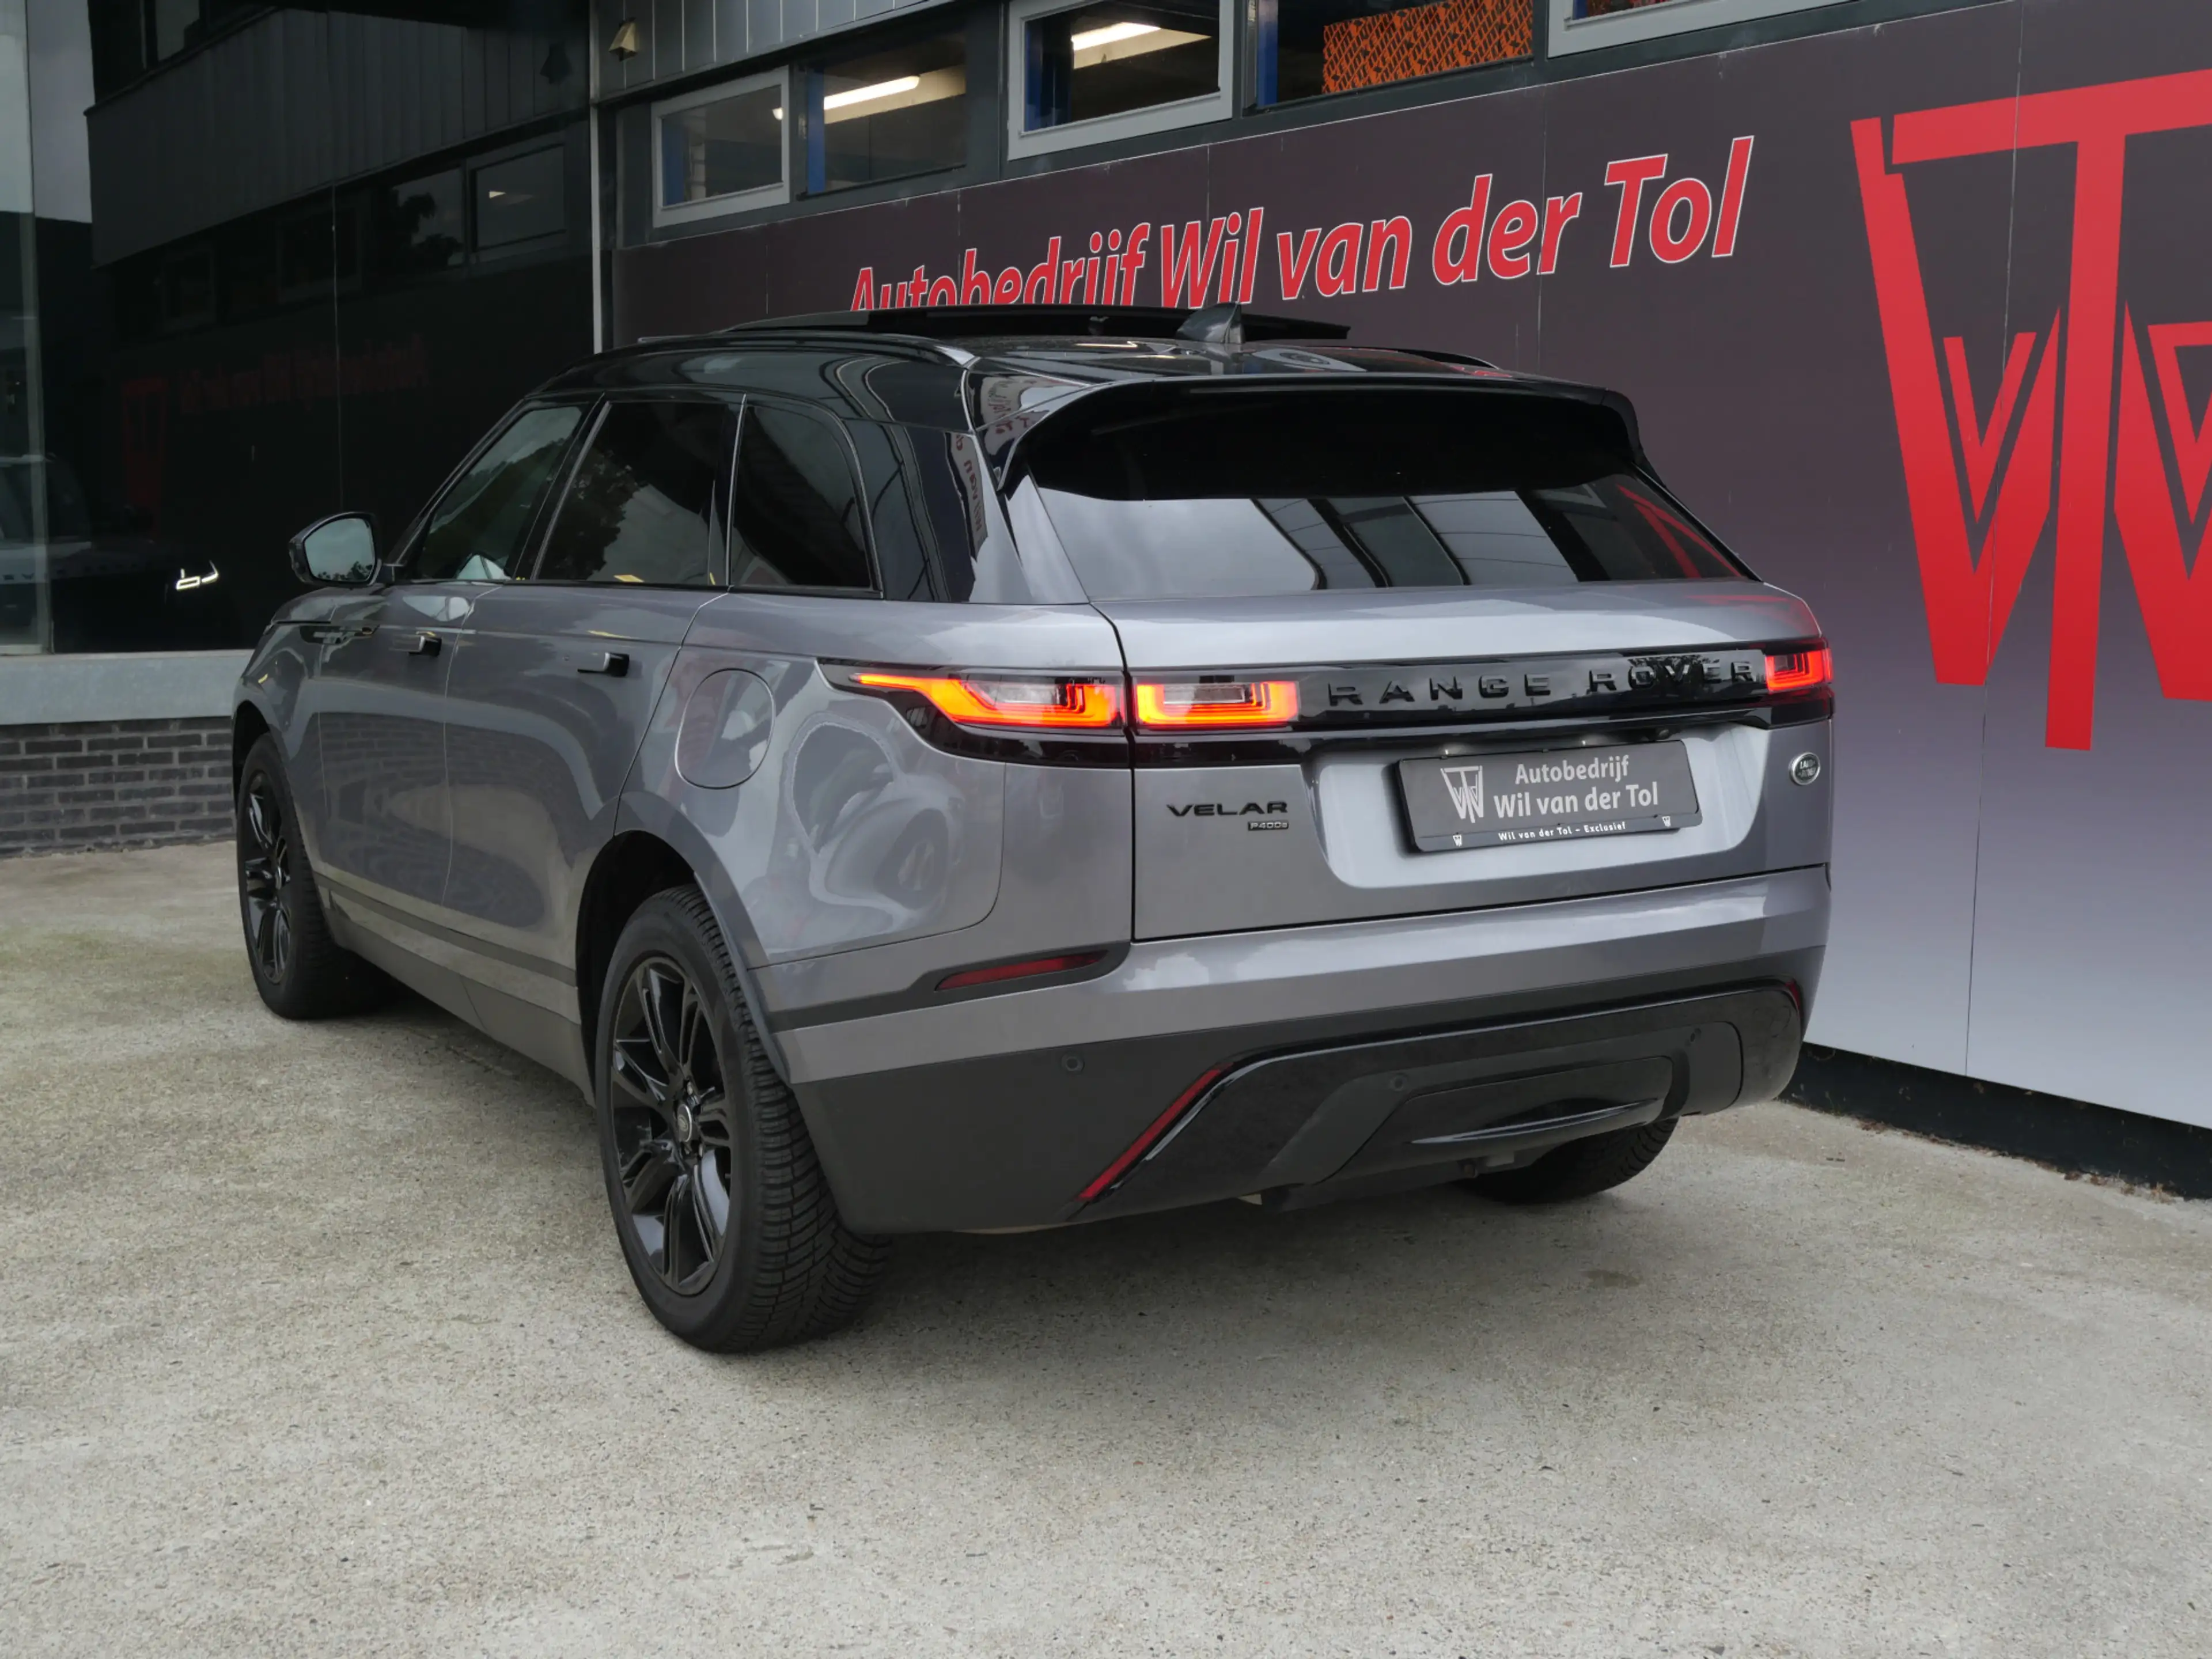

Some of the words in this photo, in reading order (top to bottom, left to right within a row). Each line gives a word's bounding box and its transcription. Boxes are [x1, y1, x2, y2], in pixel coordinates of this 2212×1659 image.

[1161, 207, 1264, 309] Wil
[1277, 215, 1412, 300] van
[1432, 173, 1582, 285] der
[1604, 135, 1754, 268] Tol
[1328, 673, 1551, 706] RANGE
[1587, 661, 1752, 692] ROVER
[1515, 755, 1629, 785] Autobedrijf
[1166, 801, 1289, 817] VELAR
[1494, 791, 1531, 819] Wil
[1536, 794, 1578, 815] van
[1585, 786, 1621, 811] der
[1626, 781, 1658, 807] Tol
[1498, 831, 1516, 841] Wil
[1539, 828, 1554, 838] der
[1556, 826, 1573, 835] Tol
[1584, 821, 1626, 833] Exclusief
